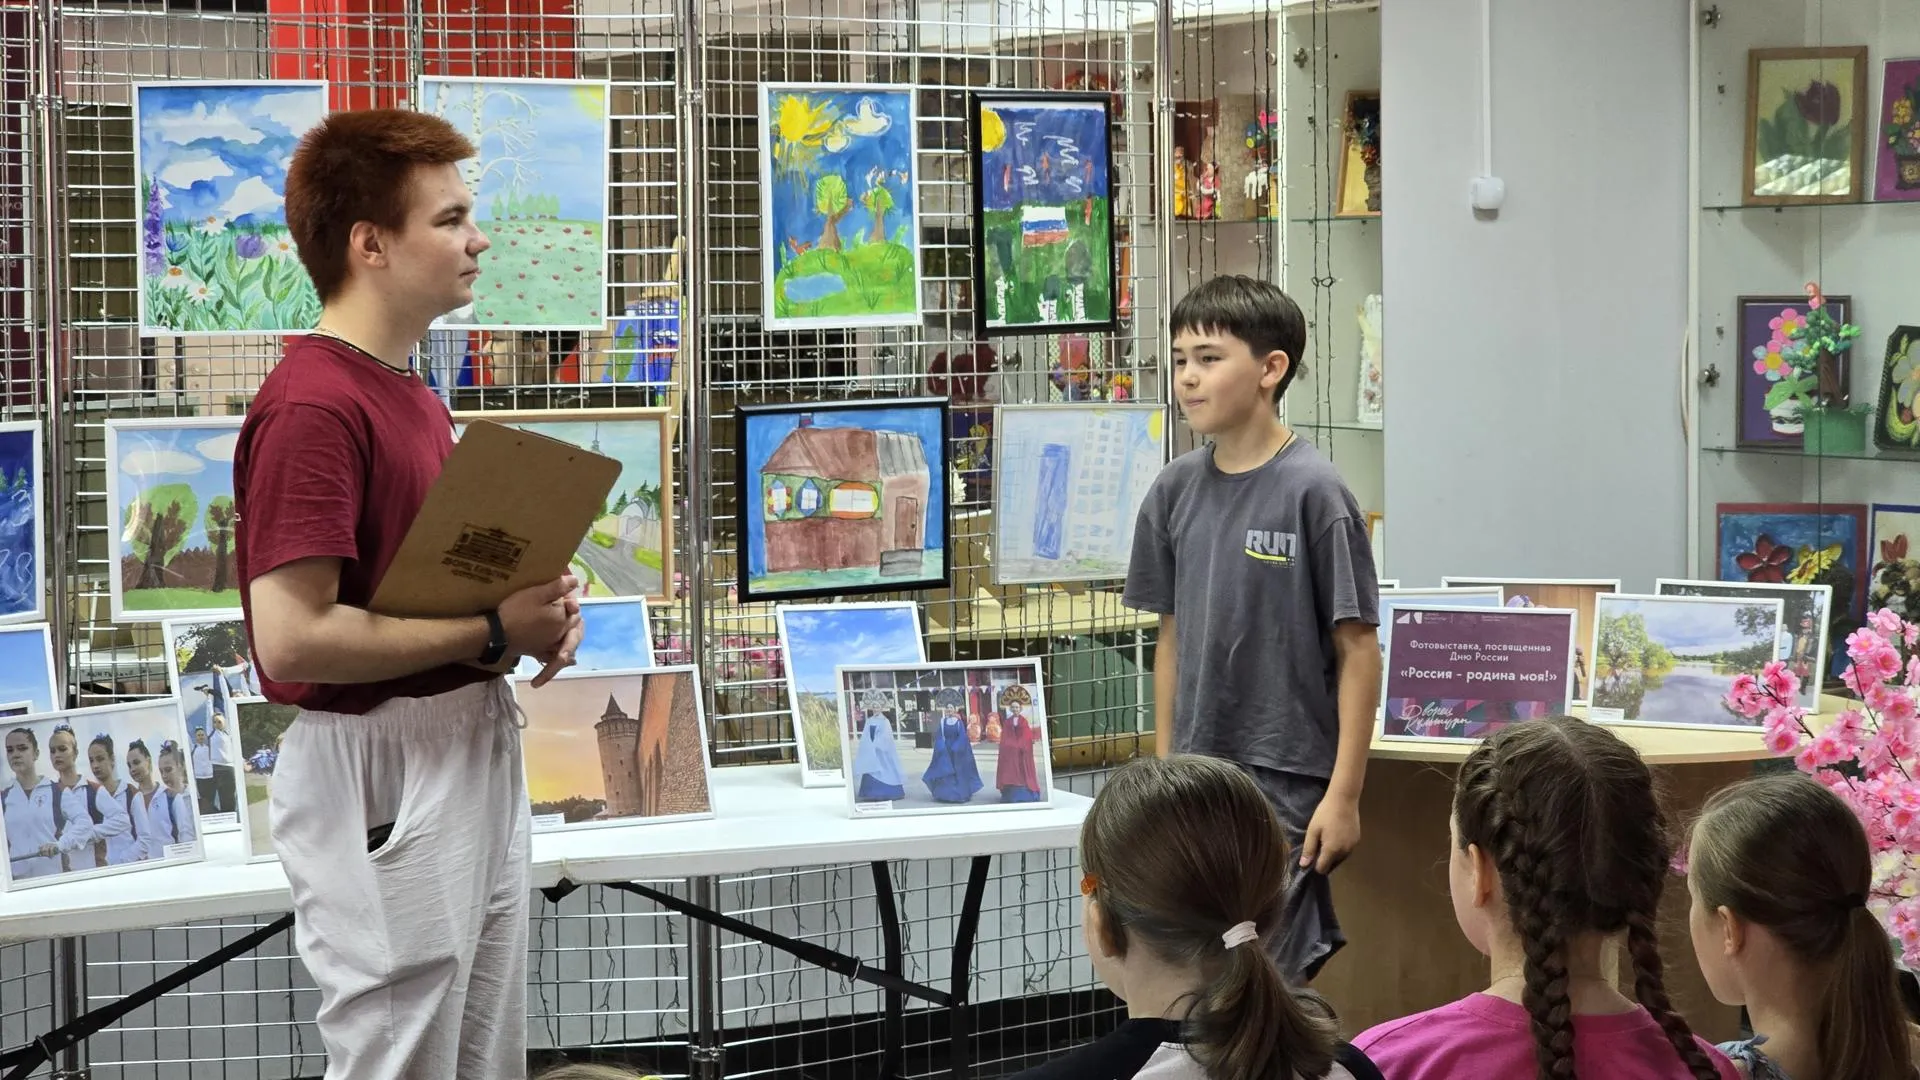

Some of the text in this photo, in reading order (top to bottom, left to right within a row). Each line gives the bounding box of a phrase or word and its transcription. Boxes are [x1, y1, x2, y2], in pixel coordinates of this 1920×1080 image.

[1410, 640, 1552, 653] Фотовыставка, посвященная
[1450, 652, 1509, 662] Дню России
[1401, 667, 1452, 680] «Россия
[1466, 670, 1516, 684] родина
[1520, 670, 1557, 682] моя!»
